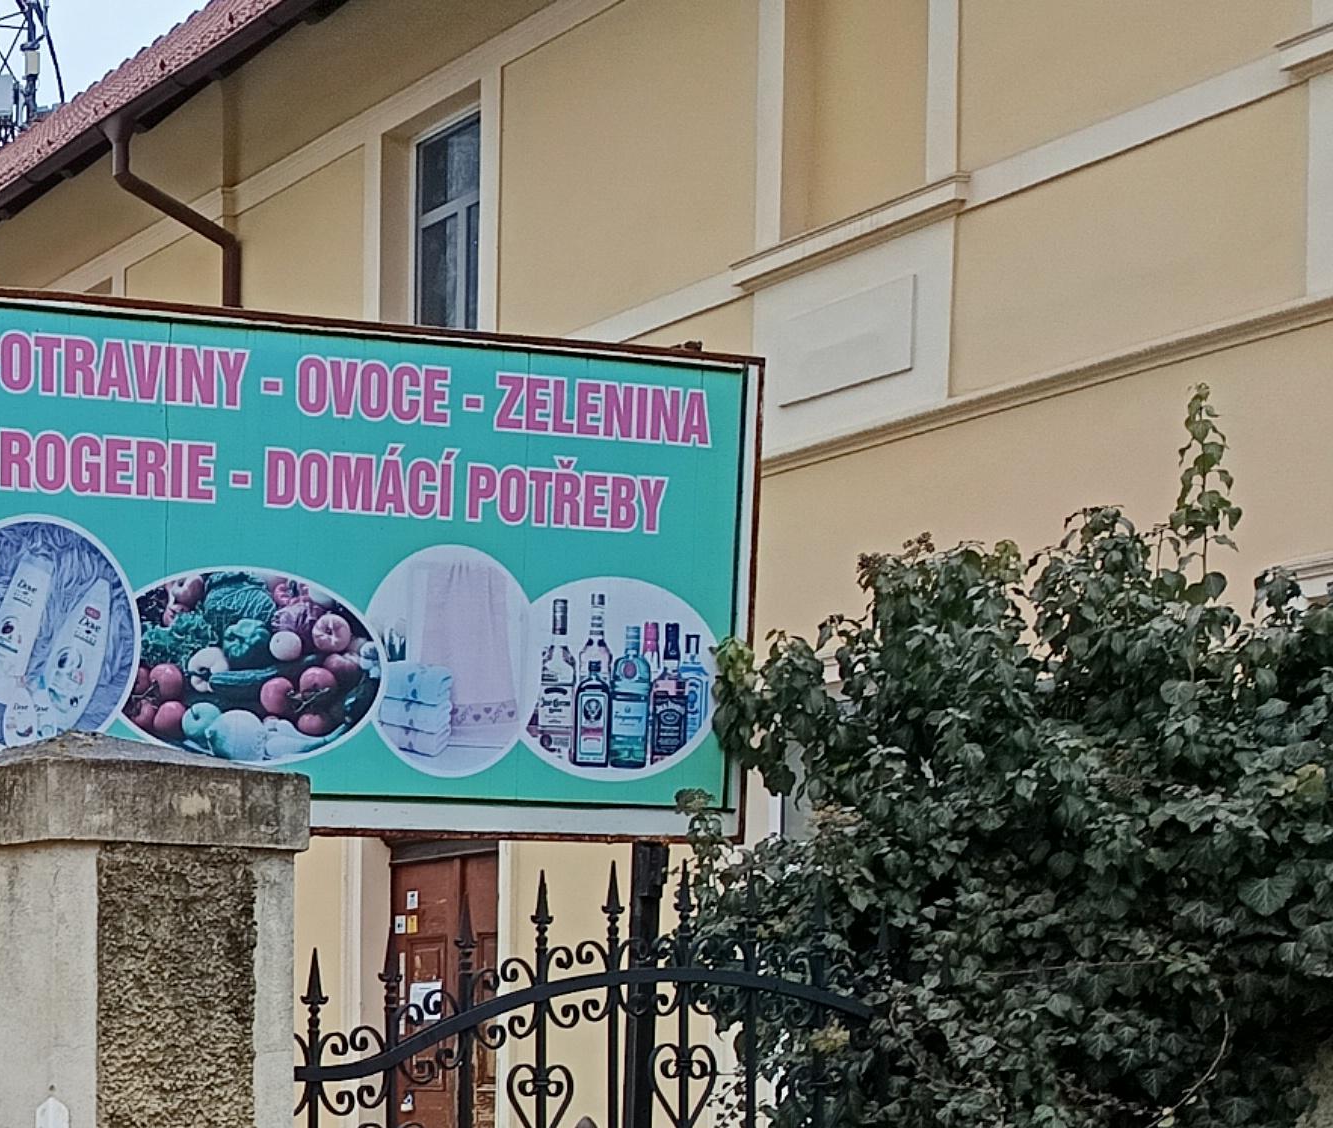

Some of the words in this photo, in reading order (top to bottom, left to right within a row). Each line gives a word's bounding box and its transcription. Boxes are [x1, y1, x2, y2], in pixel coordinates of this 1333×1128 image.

[296, 354, 452, 427] OVOCE
[494, 371, 712, 448] ZELENINA
[265, 443, 460, 521] DOMÁCÍ
[466, 456, 668, 534] POTŘEBY
